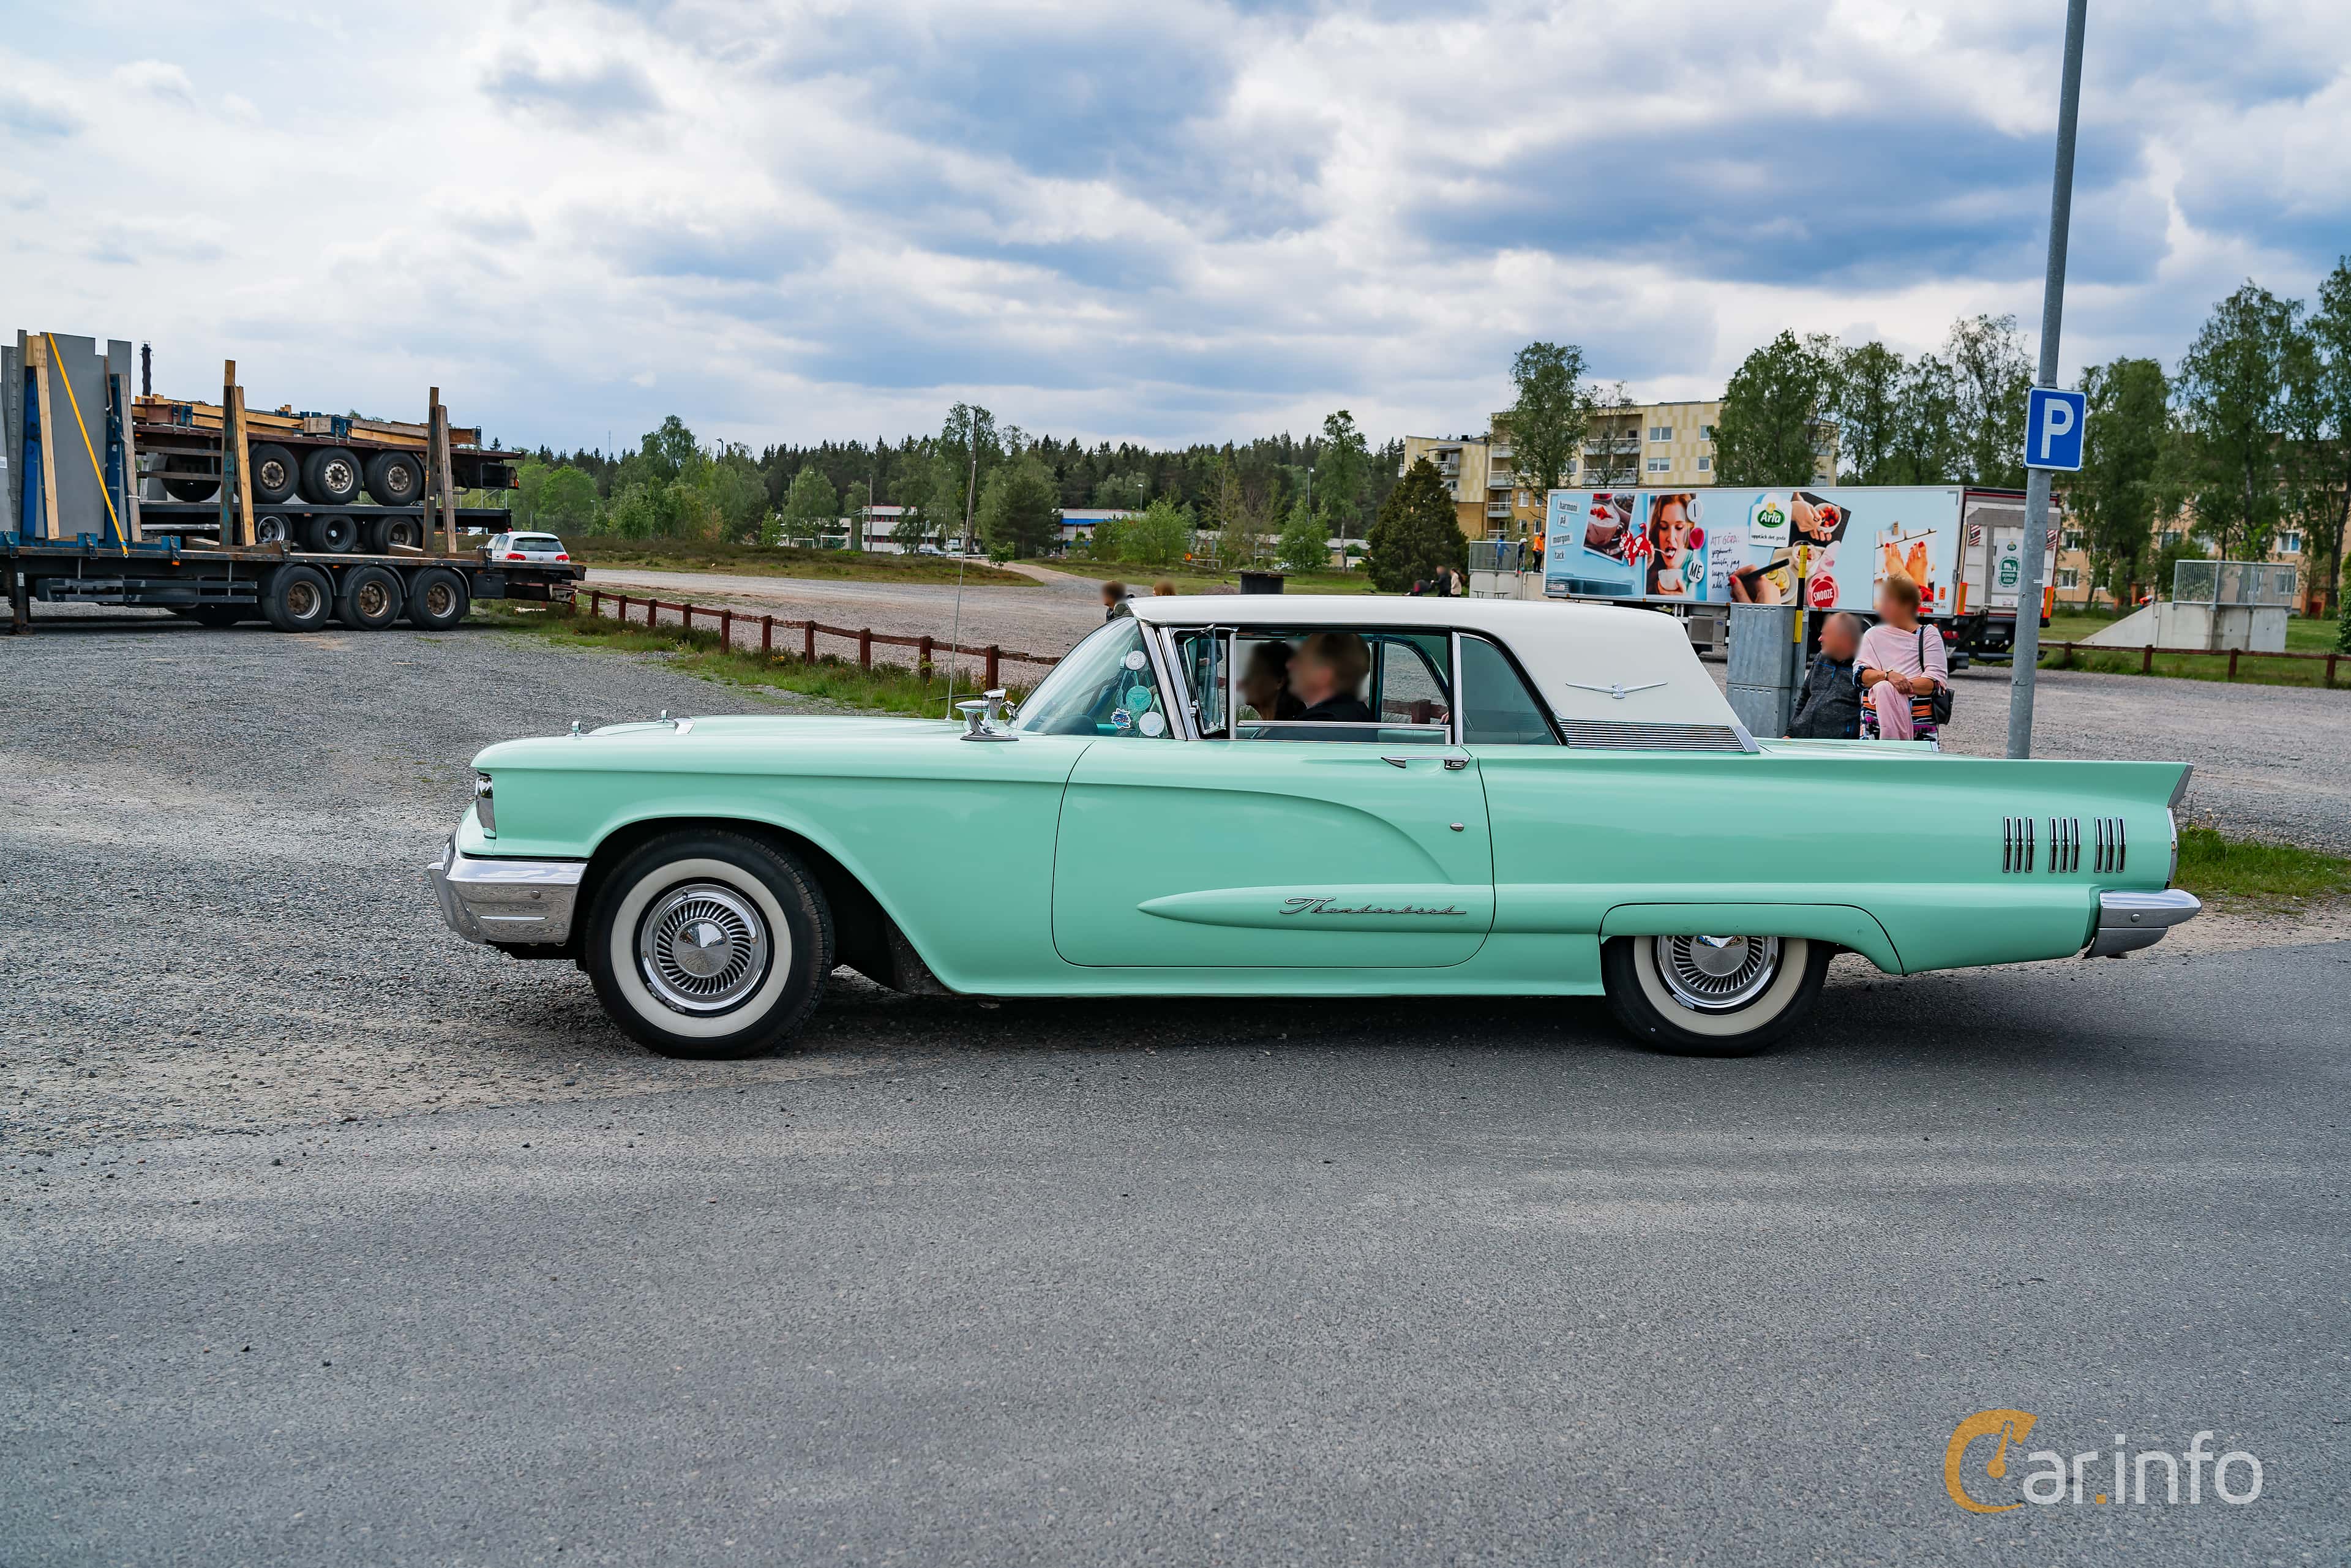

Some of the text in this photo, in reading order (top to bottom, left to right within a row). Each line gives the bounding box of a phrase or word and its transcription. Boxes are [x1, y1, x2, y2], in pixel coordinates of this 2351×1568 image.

[2041, 398, 2074, 459] P
[1559, 501, 1577, 512] harmoni
[1693, 503, 1697, 517] I
[1760, 511, 1781, 524] Arla
[1553, 535, 1570, 544] morgon
[1710, 535, 1722, 546] ATT
[1554, 551, 1564, 560] tack
[1689, 563, 1702, 579] ME
[1813, 588, 1834, 602] SNOOZE
[1280, 896, 1466, 914] Thunderbird
